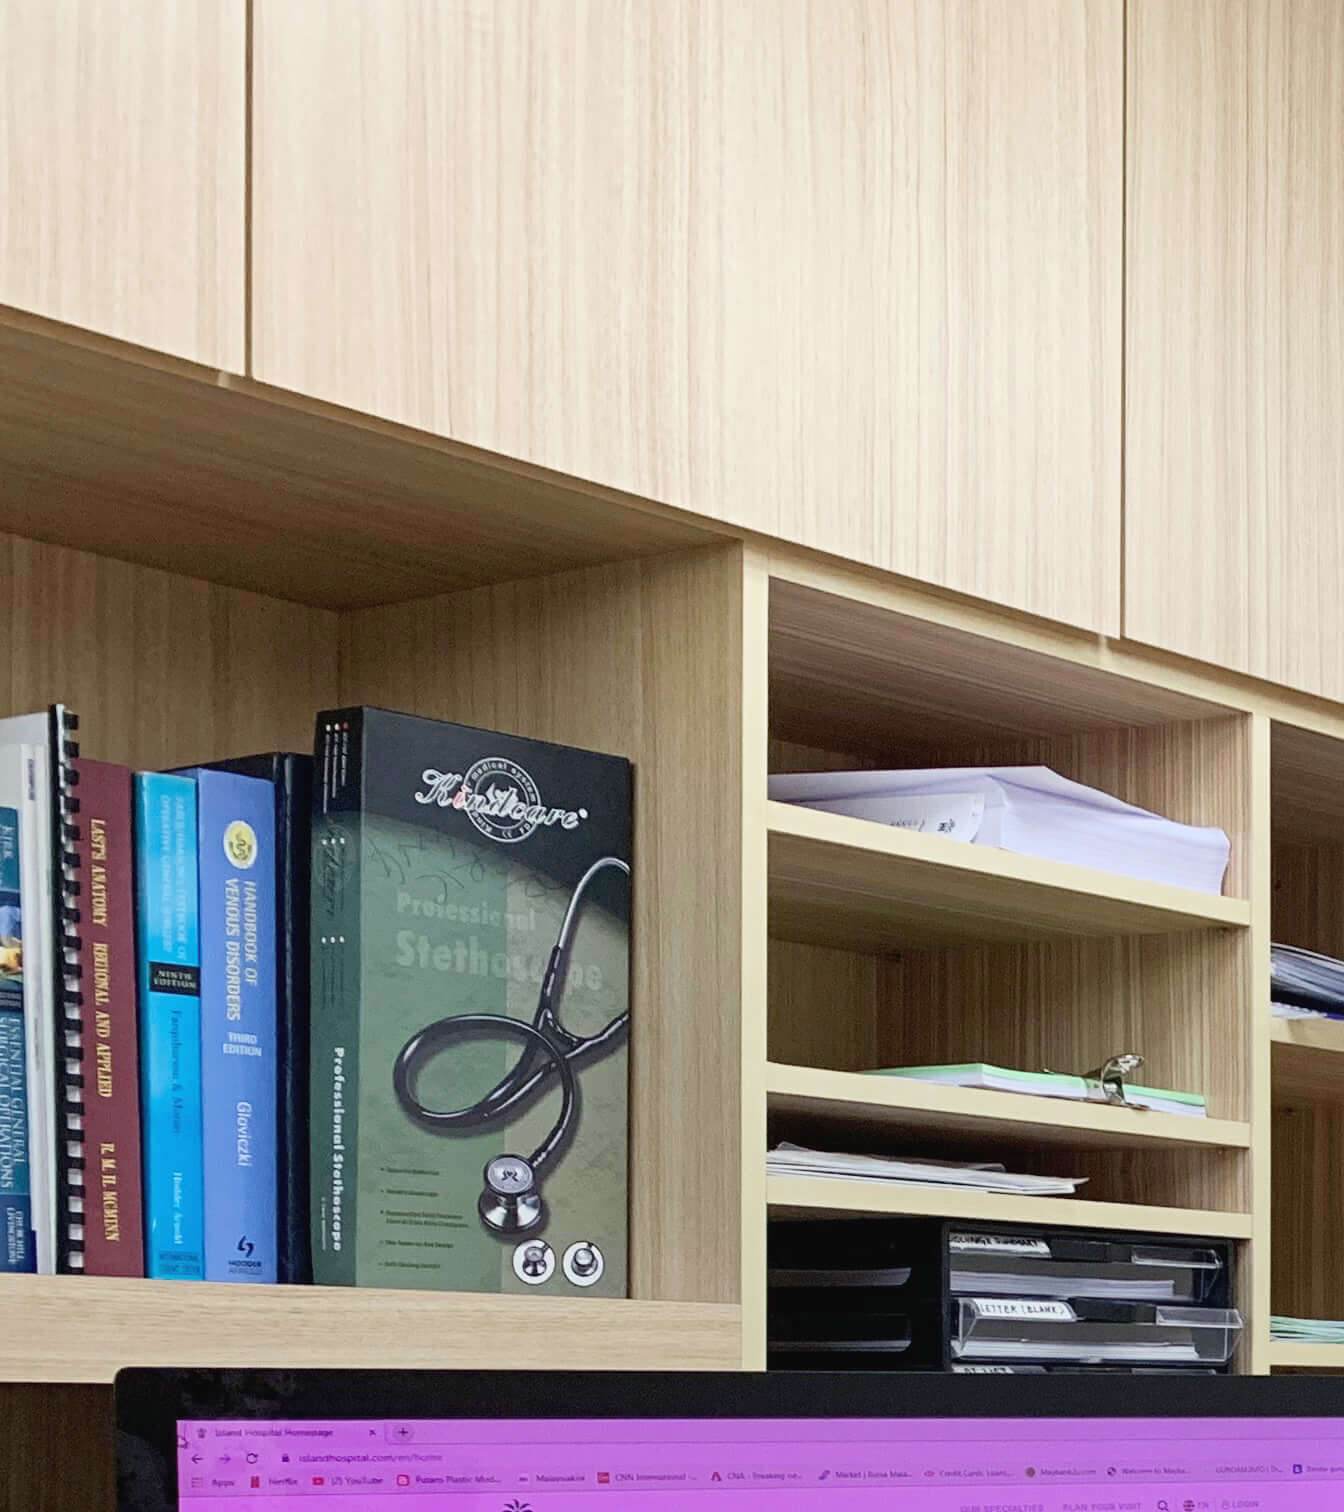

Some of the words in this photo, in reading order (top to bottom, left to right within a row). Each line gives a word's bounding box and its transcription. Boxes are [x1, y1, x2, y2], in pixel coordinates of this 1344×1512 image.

[92, 864, 107, 926] ANATOMY
[225, 878, 240, 937] VENOUS
[244, 881, 258, 963] HANDBOOK
[93, 942, 109, 1007] REGIONAL
[153, 977, 197, 989] EDITION
[226, 941, 242, 1021] DISORDERS
[245, 968, 258, 986] OF
[396, 930, 602, 990] Stethoscpe
[10, 1017, 22, 1090] ESSENTIAL
[95, 1010, 111, 1038] AND
[223, 1043, 262, 1057] EDITION
[228, 1032, 257, 1044] THIRD
[96, 1041, 113, 1099] APPLIED
[333, 1047, 345, 1150] Professional
[1, 1095, 15, 1189] OPERATIONS
[13, 1095, 25, 1165] GENERAL
[237, 1101, 252, 1167] Gloviczki
[103, 1190, 120, 1242] MCMINN
[333, 1153, 344, 1251] Stethoscope
[981, 1303, 1016, 1315] LETTER
